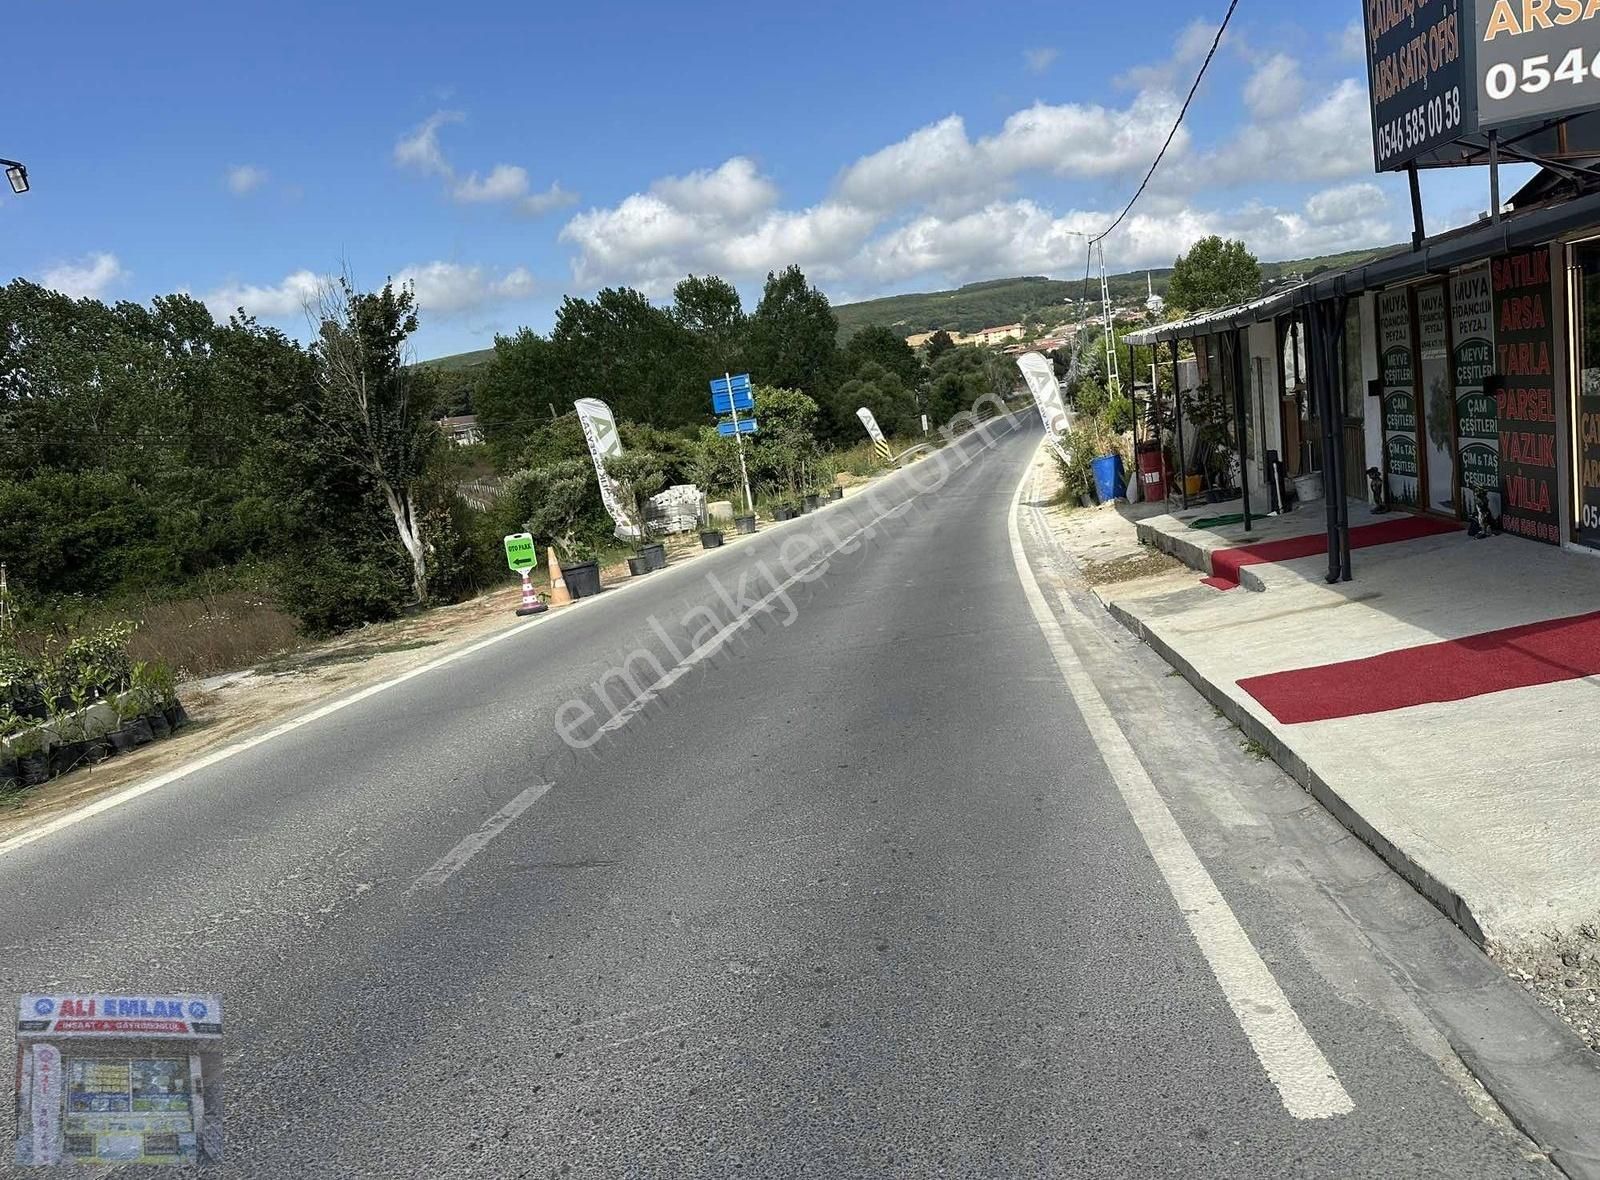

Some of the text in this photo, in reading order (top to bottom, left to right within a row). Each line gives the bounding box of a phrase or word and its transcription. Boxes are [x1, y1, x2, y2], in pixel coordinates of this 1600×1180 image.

[1483, 0, 1600, 41] ARS
[1375, 0, 1459, 105] ARSA SATIŞ OFİSİ
[1485, 47, 1600, 99] 054
[1378, 86, 1460, 161] 0546 585 00 58
[1492, 249, 1550, 292] SATILIK
[1454, 277, 1489, 301] MUYA
[1382, 295, 1407, 313] MUYA
[1500, 293, 1546, 332] ARSA
[1459, 318, 1488, 334] PEYZAJ
[1388, 352, 1408, 367] MEYVE
[1461, 346, 1489, 362] MEYVE
[1497, 341, 1551, 376] TARLA
[1456, 362, 1493, 384] ÇEŞİTLER
[1392, 397, 1408, 414] ÇAM
[1467, 399, 1487, 417] ÇAM
[1496, 387, 1557, 423] PARSEL
[1459, 415, 1498, 437] ÇEŞİTLERİ
[1582, 412, 1600, 452] ÇA
[1499, 430, 1557, 469] YAZLIK
[1483, 453, 1498, 476] TAŞ
[1583, 458, 1600, 488] AR
[1504, 466, 1552, 514] VİLLA
[1582, 503, 1600, 529] 05
[518, 543, 532, 552] PARK
